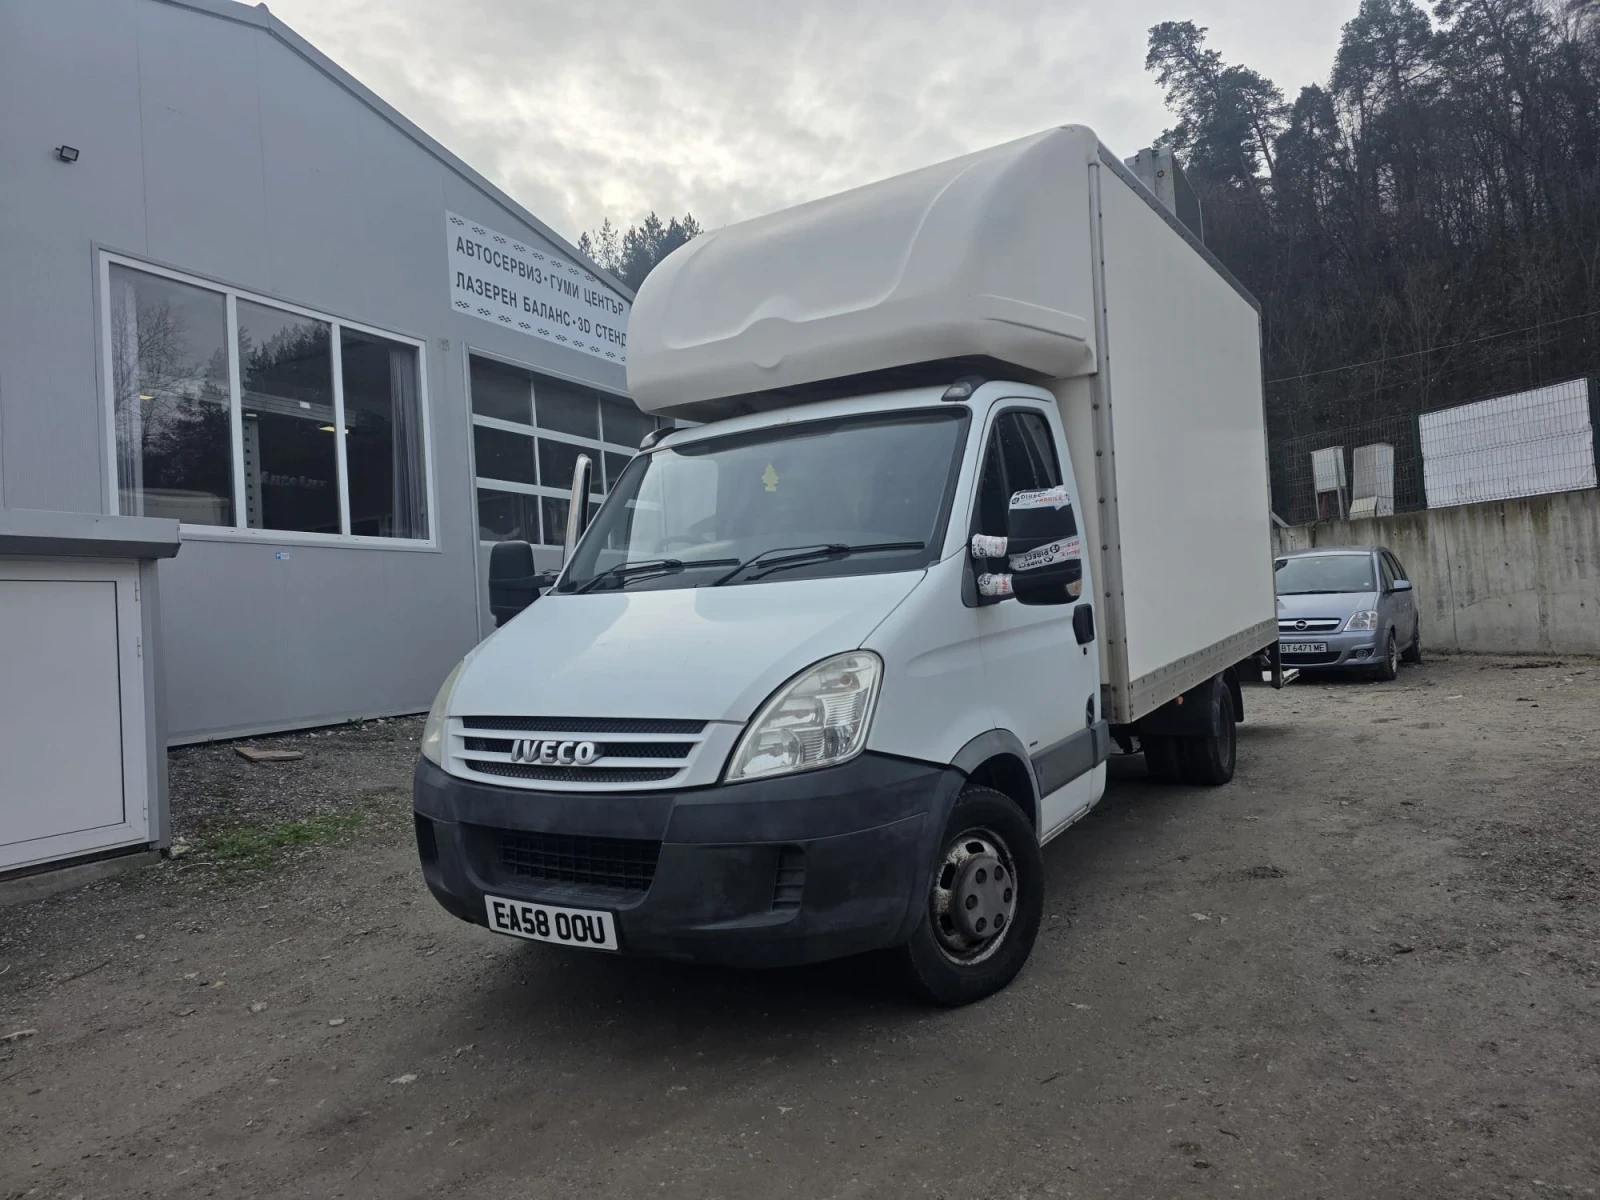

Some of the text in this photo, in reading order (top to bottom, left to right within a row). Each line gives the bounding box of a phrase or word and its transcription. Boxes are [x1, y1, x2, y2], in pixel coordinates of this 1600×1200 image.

[456, 236, 624, 316] АВТОСЕРВИЗ ГУМИ ЦЕНТЪР
[456, 271, 518, 308] ЛАЗЕРЕН
[523, 295, 571, 327] БАЛАНС
[577, 316, 591, 334] 3D
[1024, 550, 1048, 562] DIRECT
[1281, 643, 1325, 652] BT 6471 ME
[511, 739, 595, 765] IVECO
[493, 901, 606, 944] EA58 OOU
